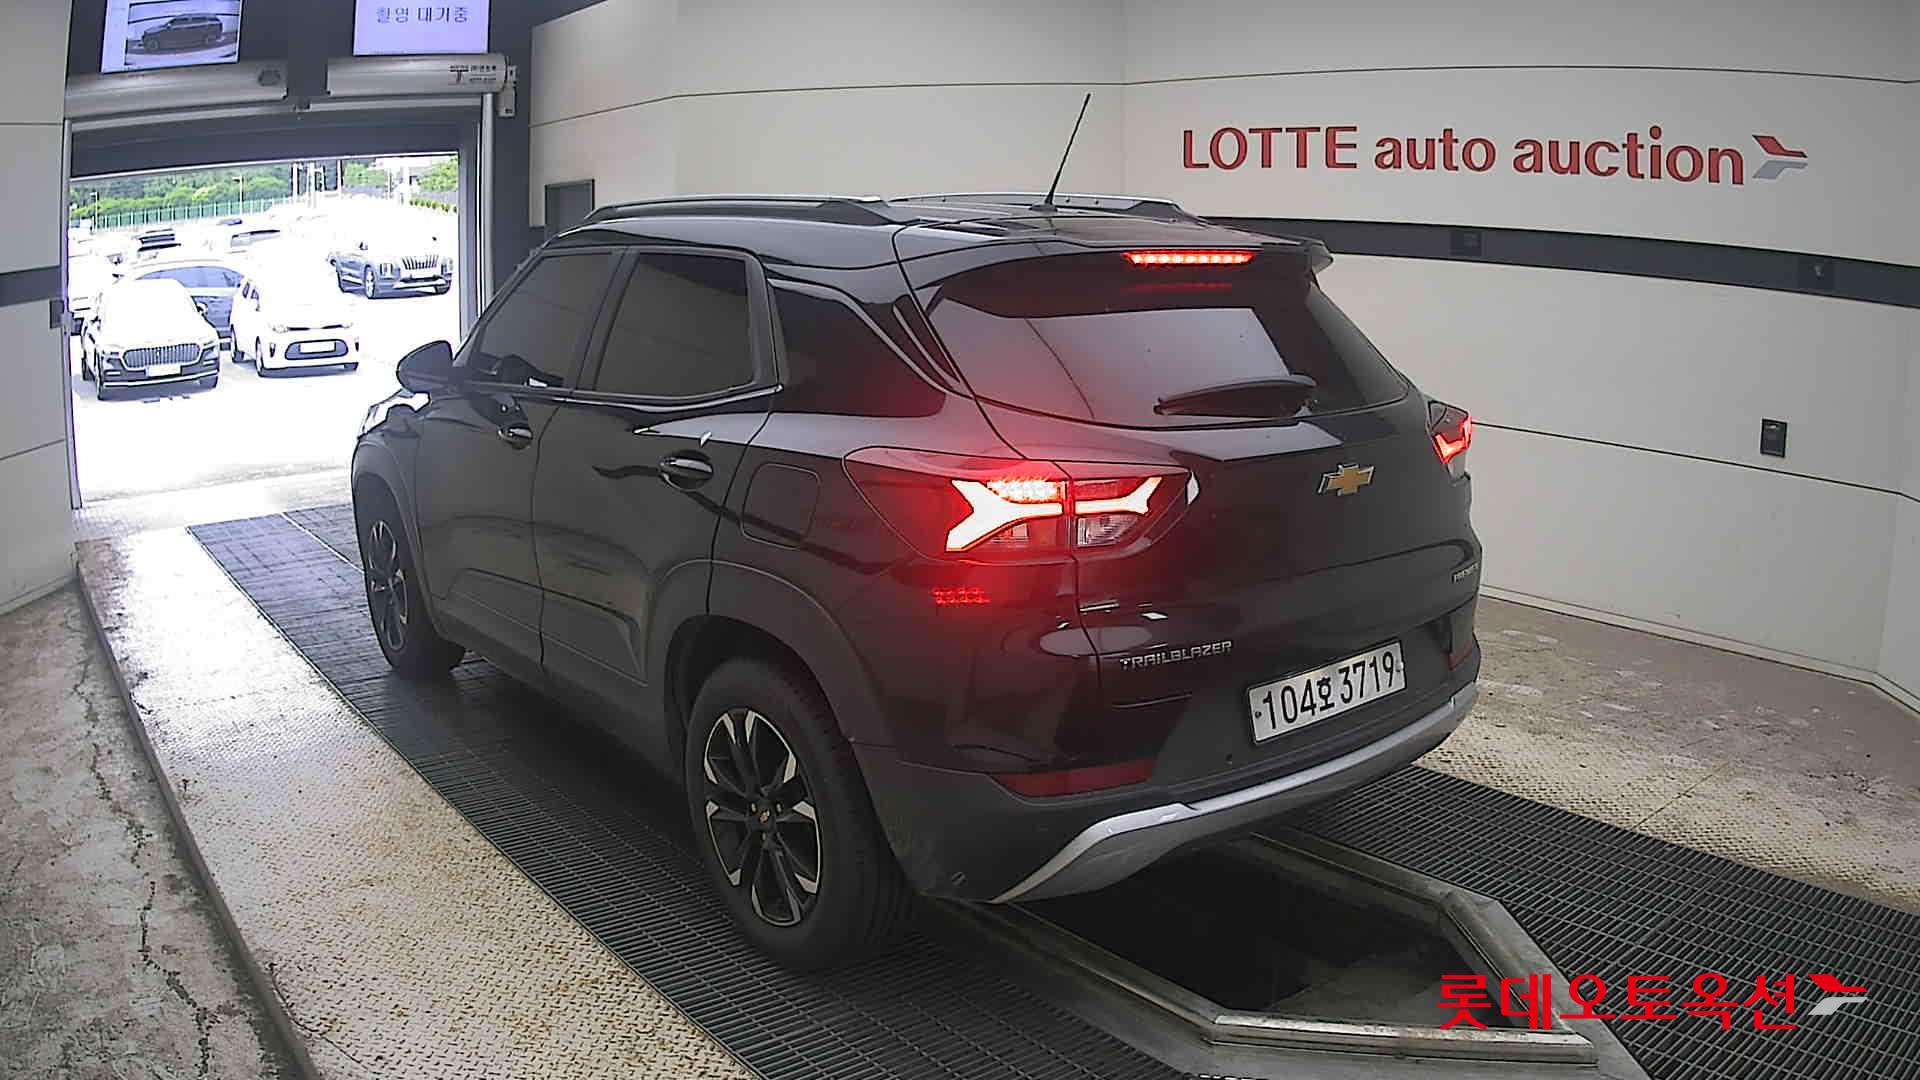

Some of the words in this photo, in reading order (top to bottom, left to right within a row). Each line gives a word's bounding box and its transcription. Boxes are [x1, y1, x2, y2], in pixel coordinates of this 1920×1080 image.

[417, 7, 469, 24] 대기중
[1182, 126, 1358, 171] LOTTE
[1374, 127, 1497, 172] auto
[1512, 125, 1745, 186] auction
[1119, 640, 1232, 670] TRAILBLAZER
